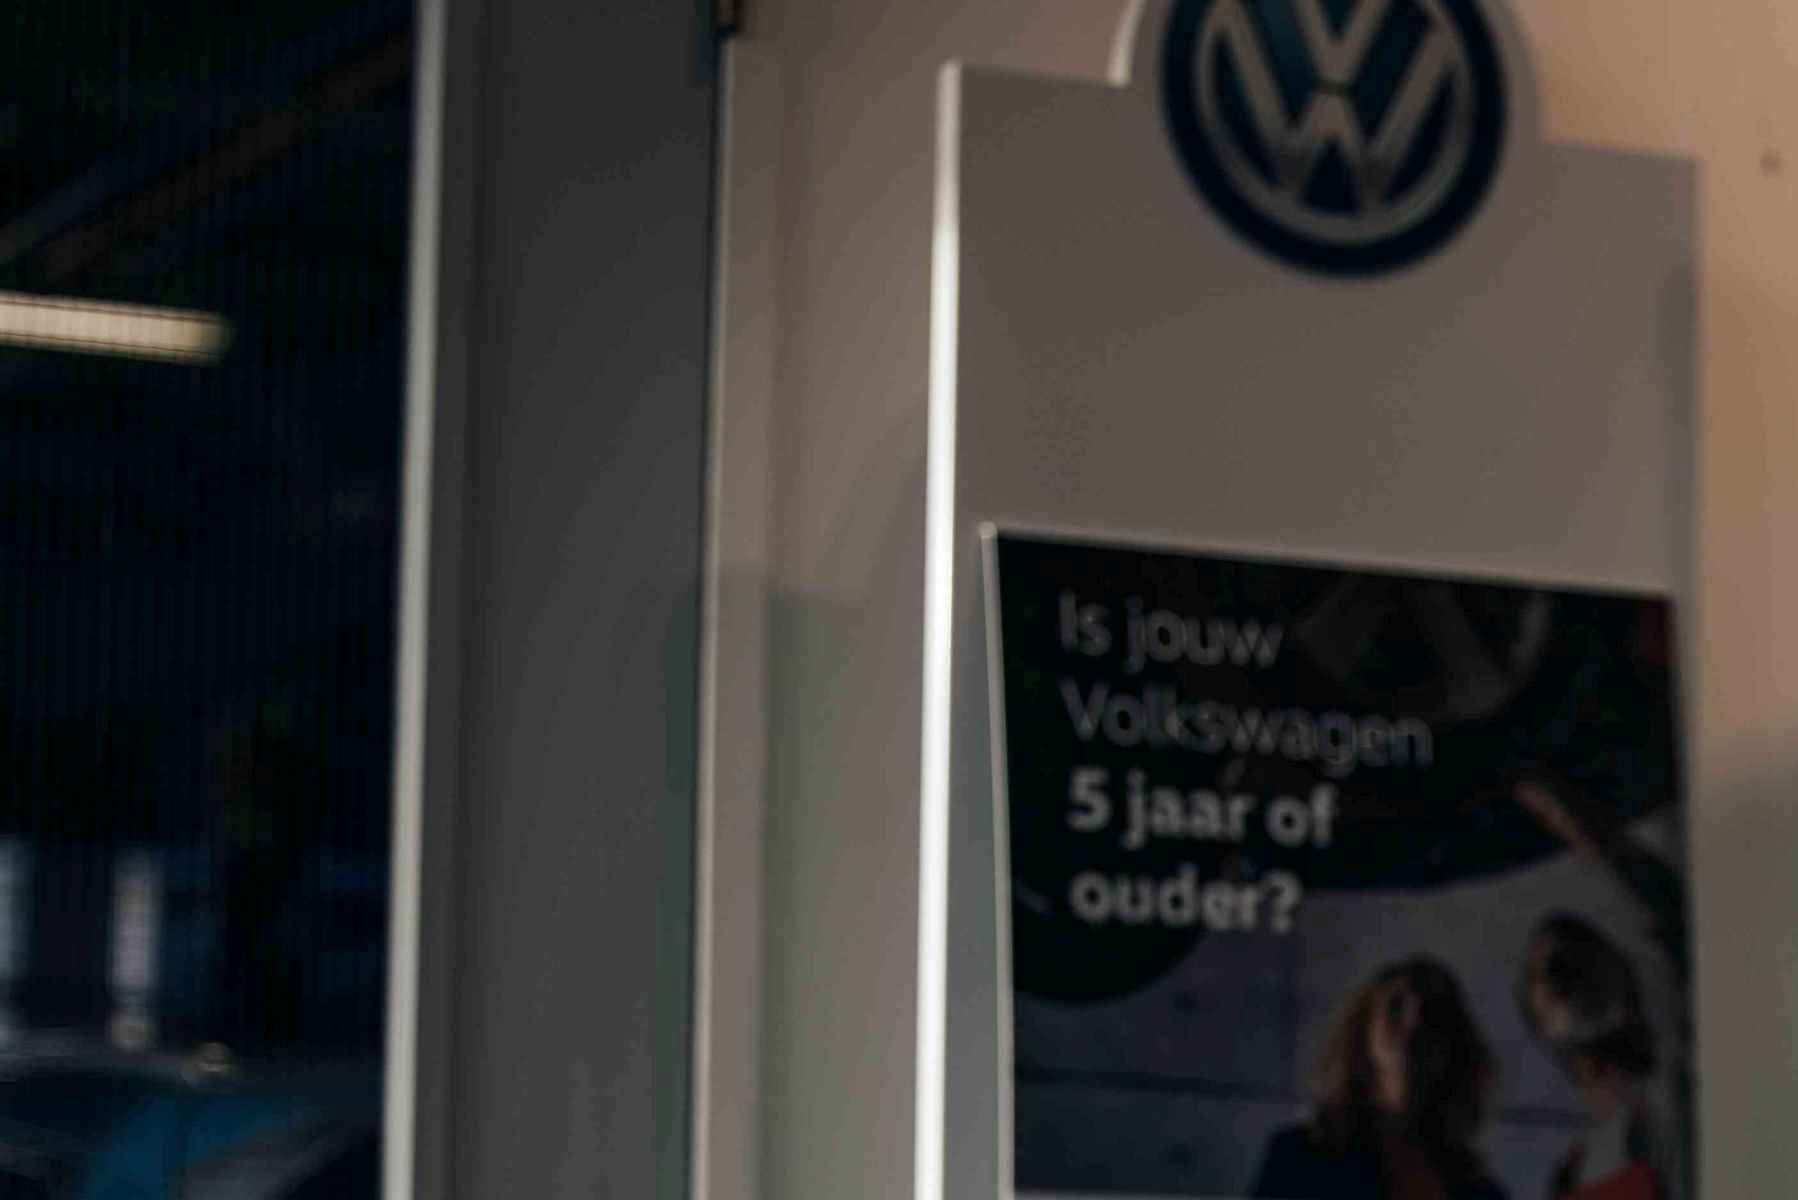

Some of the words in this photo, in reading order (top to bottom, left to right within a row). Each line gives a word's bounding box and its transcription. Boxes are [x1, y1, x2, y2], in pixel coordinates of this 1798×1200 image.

[1055, 588, 1114, 658] Is
[1120, 594, 1285, 676] jouw
[1058, 674, 1435, 780] Volkswagen
[1064, 764, 1114, 835] 5
[1118, 768, 1260, 854] jaar
[1262, 782, 1343, 850] of
[1066, 862, 1306, 935] ouder?
